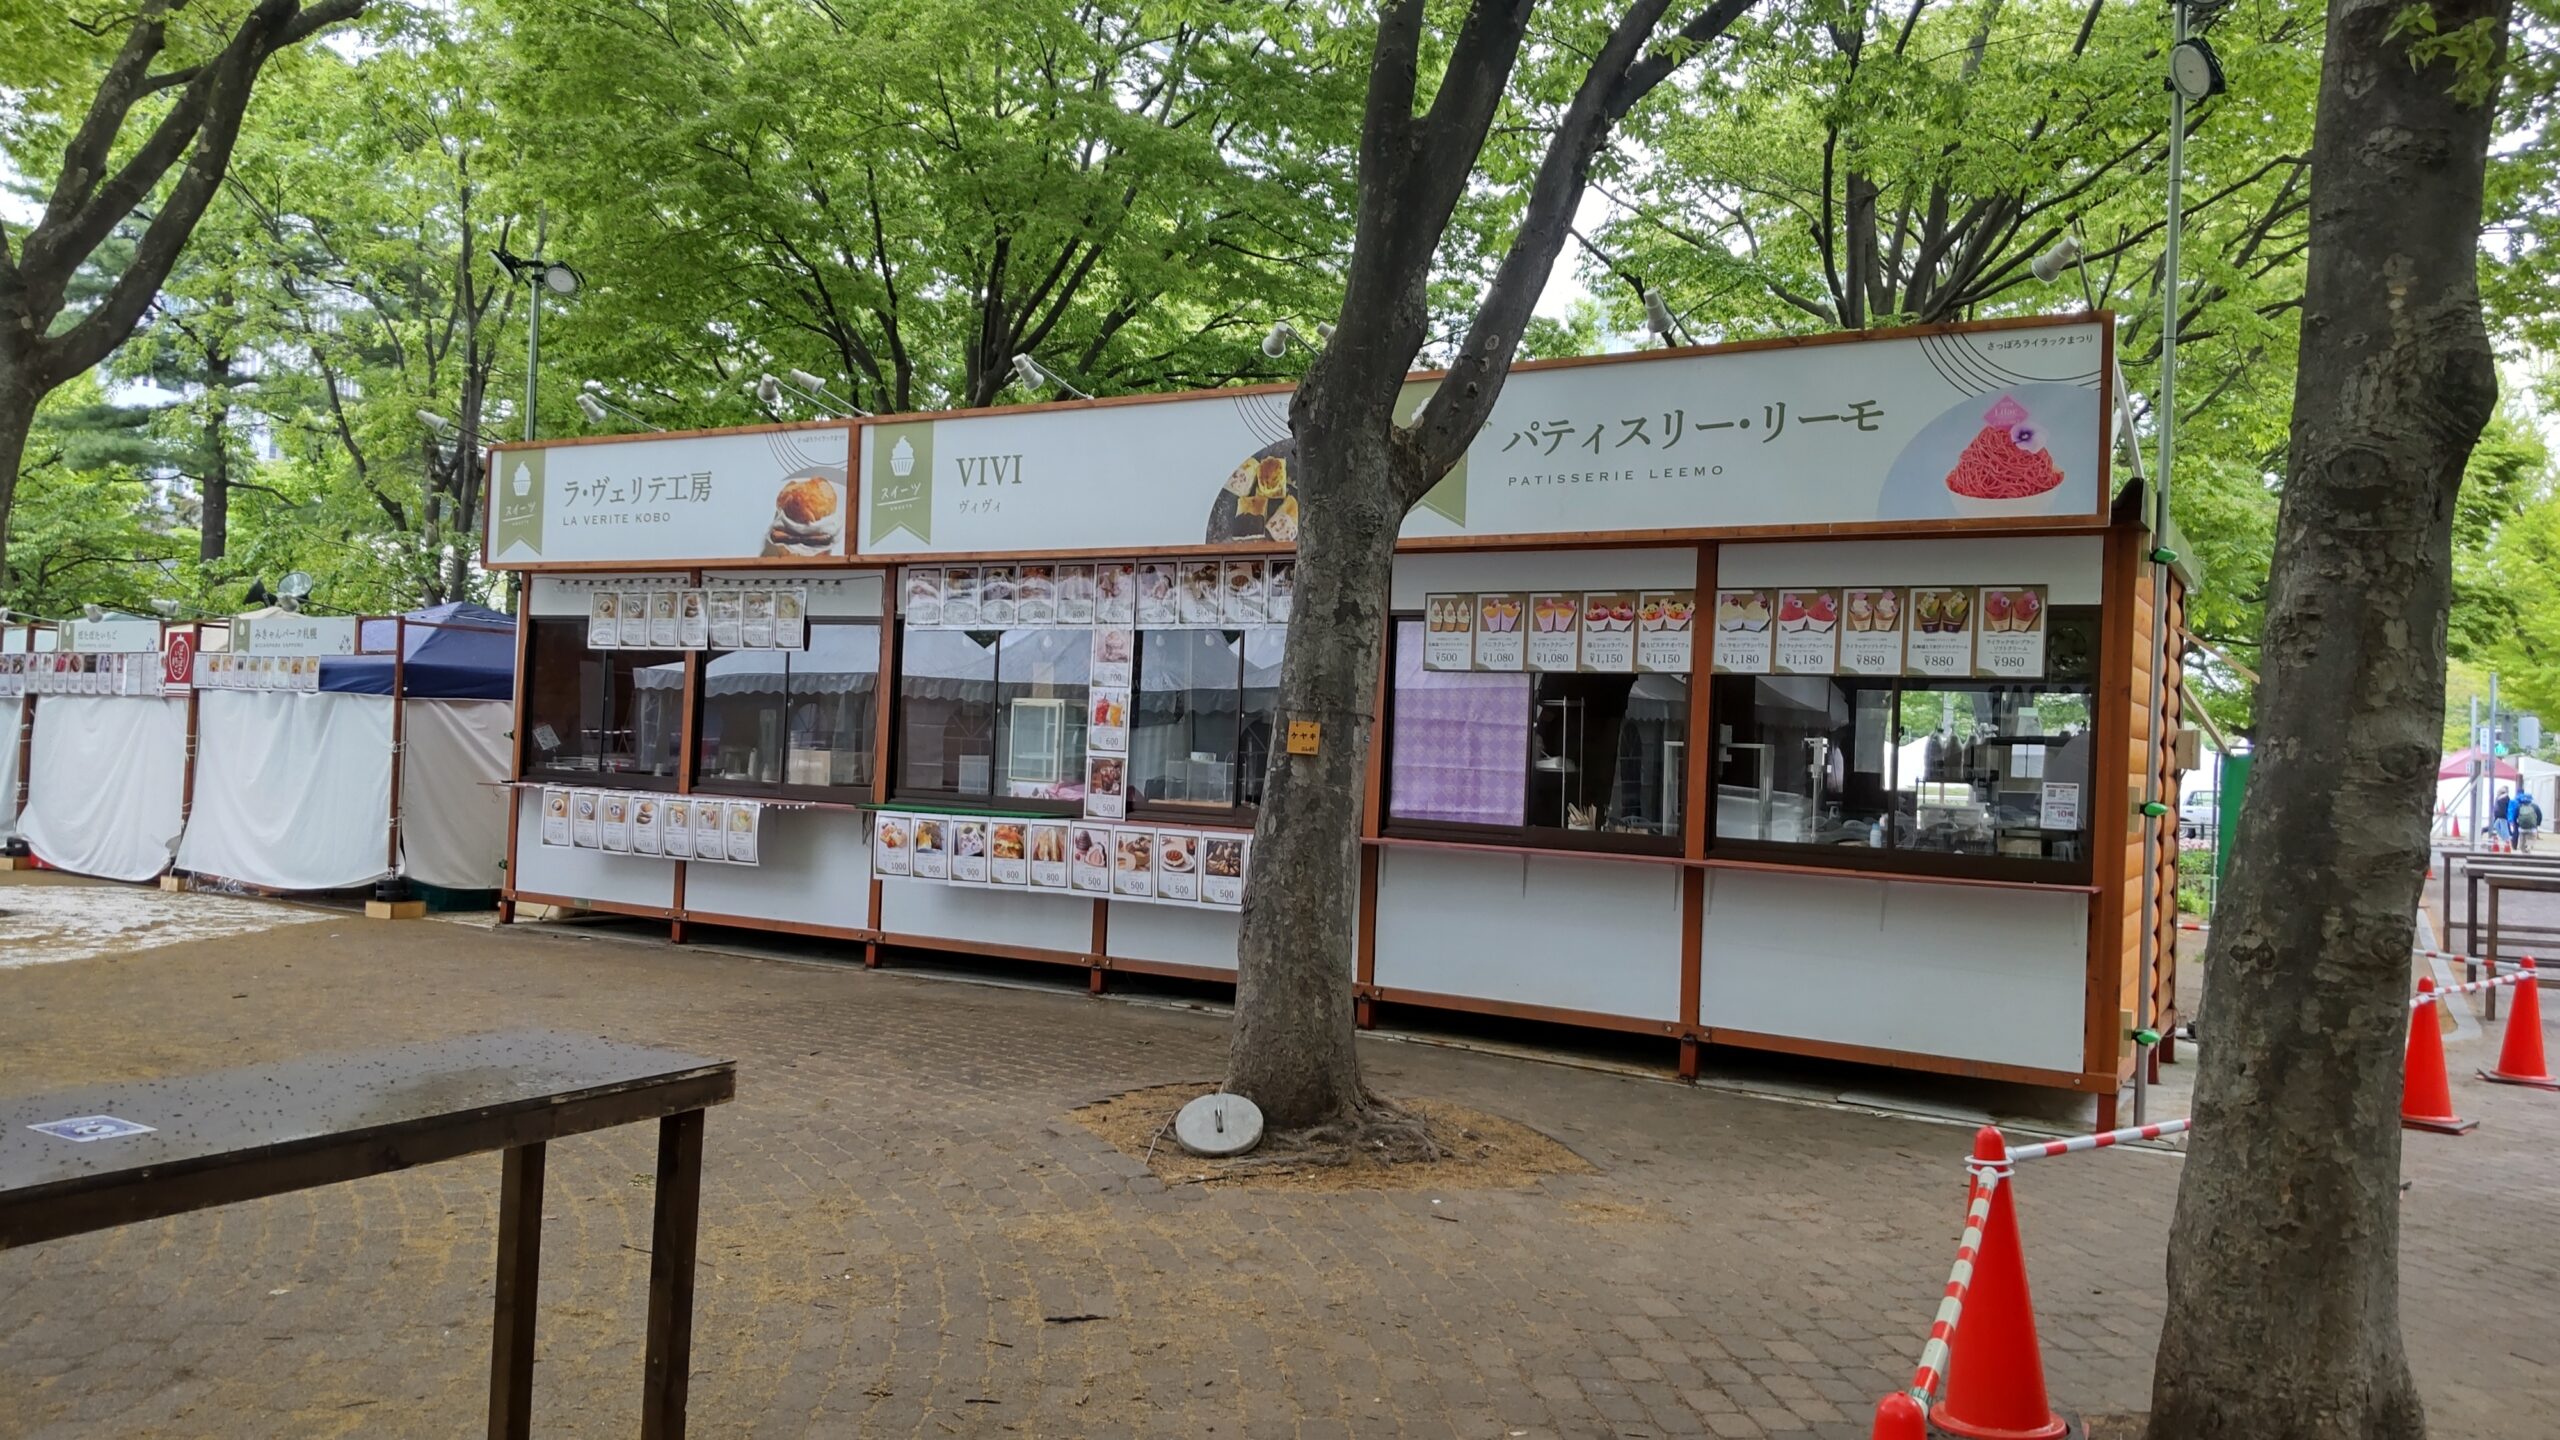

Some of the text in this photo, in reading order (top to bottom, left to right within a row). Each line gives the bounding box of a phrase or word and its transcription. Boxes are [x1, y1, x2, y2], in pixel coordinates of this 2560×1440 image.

[1987, 334, 2093, 351] さっぽろライラックまつり
[1502, 399, 1885, 456] パティスリー・リーモ
[955, 454, 1023, 488] VIVI
[1508, 465, 1723, 486] PATISSERIE LEEMO
[564, 470, 712, 507] ラ・ヴェリテ工房
[881, 481, 921, 500] スイーツ
[505, 501, 537, 516] スイーツ
[959, 498, 1001, 514] ヴィヴィ
[562, 512, 671, 526] LA VERITE KOBO
[1291, 732, 1317, 742] ケヤキ
